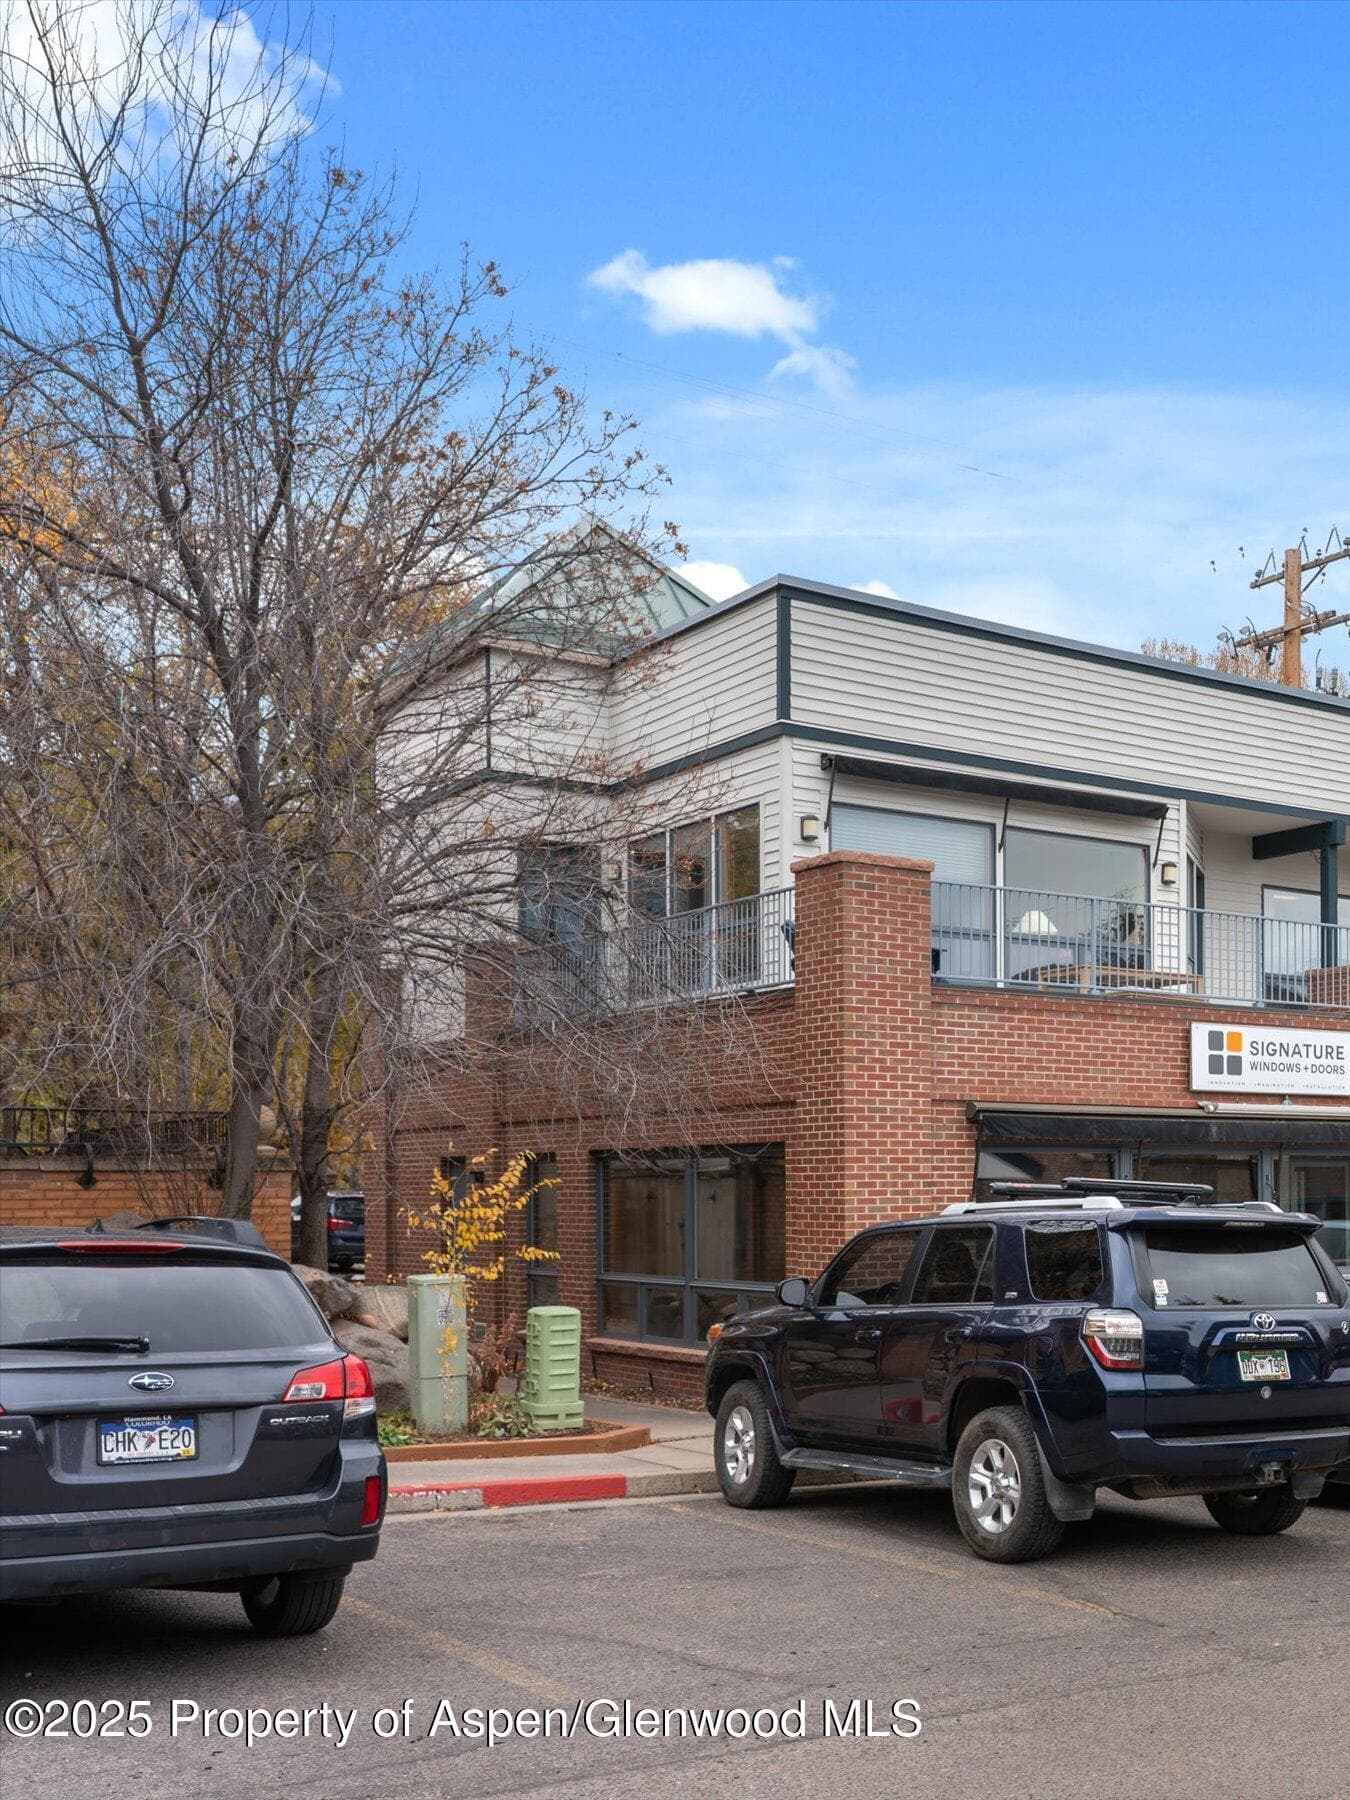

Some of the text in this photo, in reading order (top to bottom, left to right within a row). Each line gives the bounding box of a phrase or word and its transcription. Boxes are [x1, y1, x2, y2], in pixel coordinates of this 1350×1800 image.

[1249, 1040, 1345, 1060] SIGNATURE
[269, 1414, 330, 1425] OUTBACK
[104, 1428, 192, 1453] CHK E20
